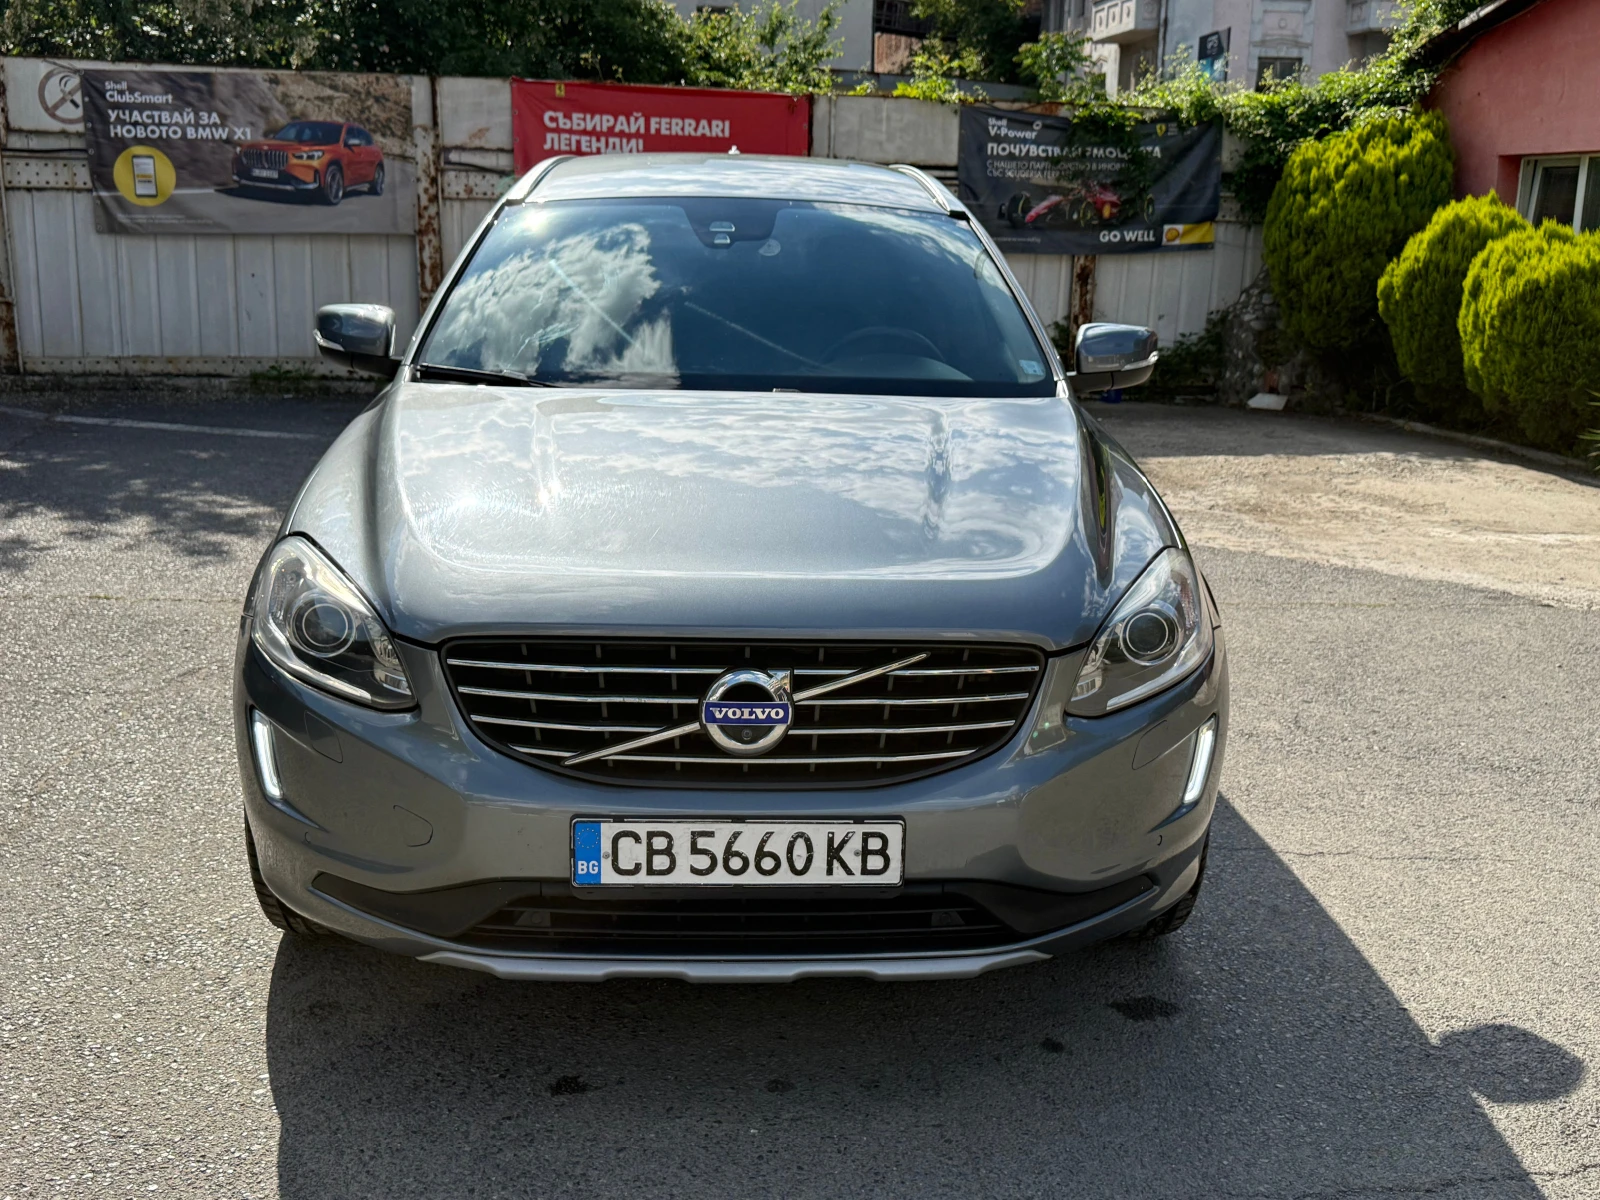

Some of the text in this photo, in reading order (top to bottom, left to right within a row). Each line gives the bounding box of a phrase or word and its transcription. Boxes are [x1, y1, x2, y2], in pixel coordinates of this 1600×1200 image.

[104, 80, 128, 90] Shell
[105, 91, 173, 104] ClubSmart
[107, 107, 221, 125] УЧАСТВАЙ ЗА
[987, 117, 1008, 127] Shell
[543, 110, 730, 138] СЪБИРАЙ FERRARI
[109, 124, 252, 141] НОВОТО BMW X1
[543, 132, 644, 154] ЛЕГЕНДИ!
[1100, 229, 1156, 242] GO WELL
[710, 707, 785, 720] VOLVO
[610, 830, 891, 877] CB 5660 KB
[577, 860, 599, 875] BG
